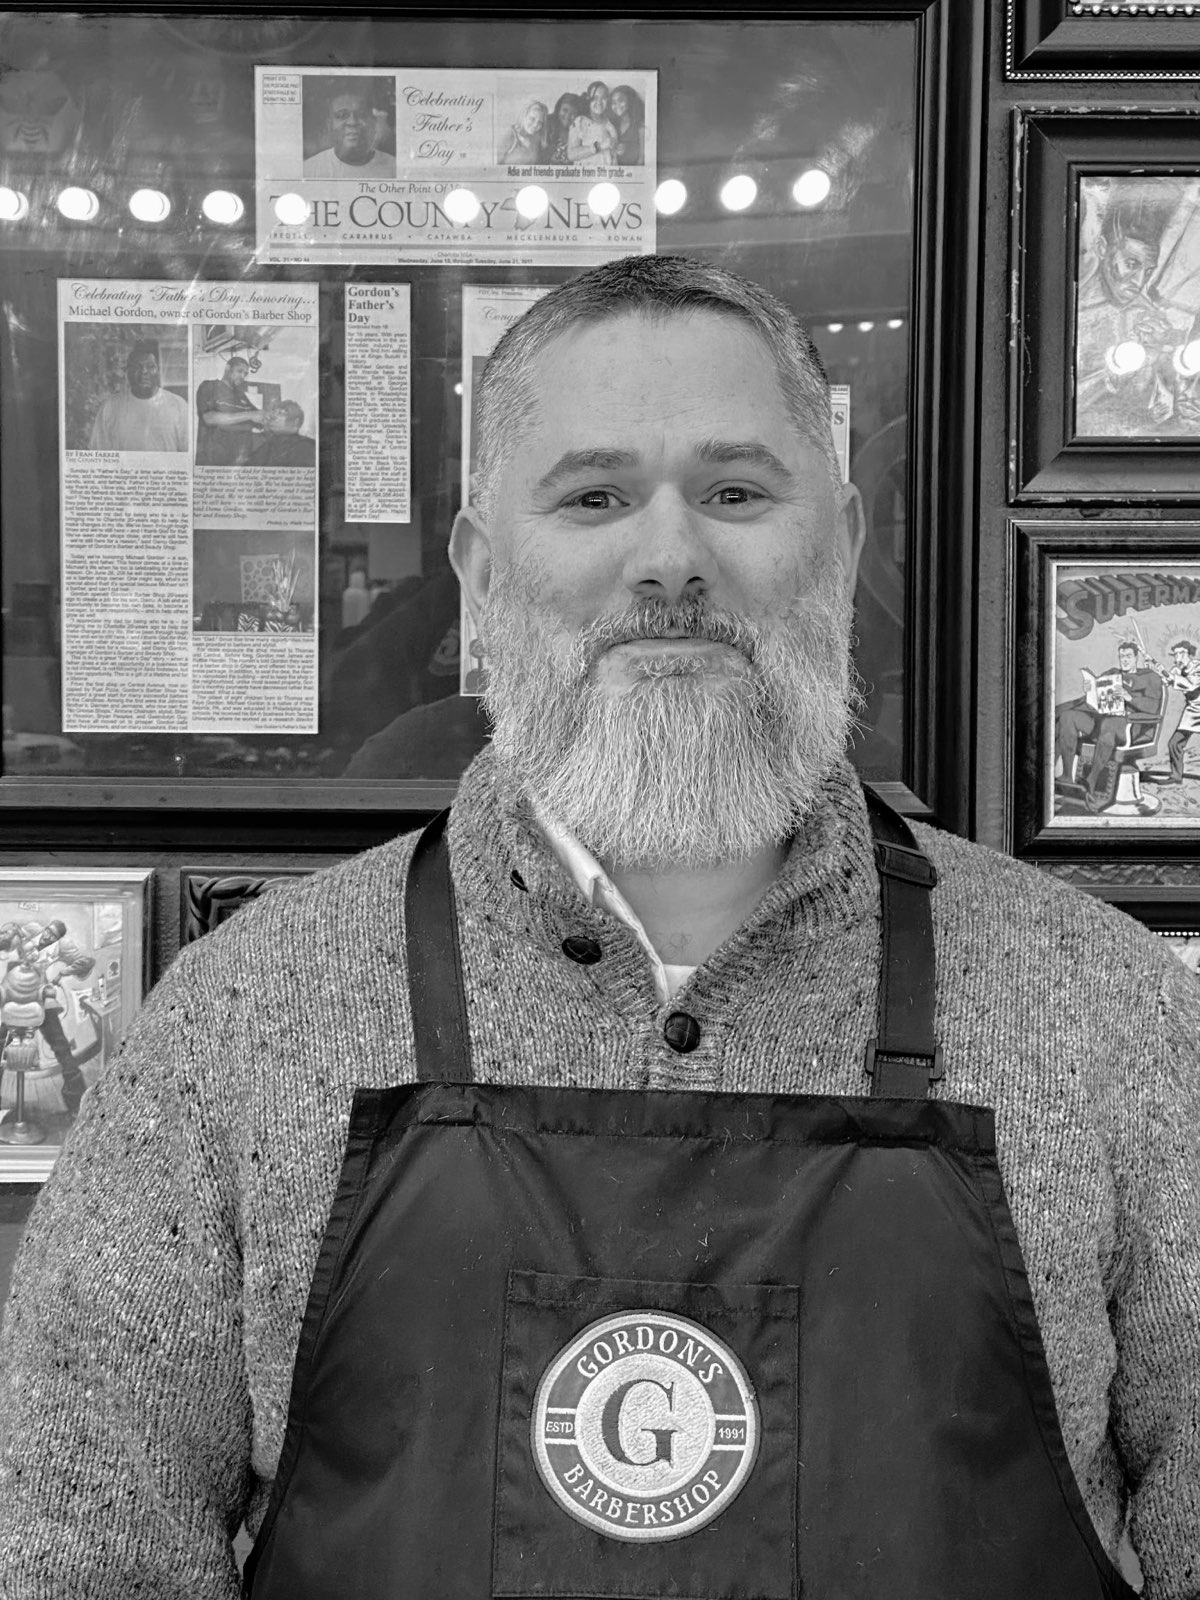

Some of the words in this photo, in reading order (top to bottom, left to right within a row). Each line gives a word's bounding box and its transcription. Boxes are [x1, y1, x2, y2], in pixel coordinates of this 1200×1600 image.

[403, 86, 485, 114] Celebrating
[412, 112, 473, 132] Father's
[417, 139, 455, 167] Day
[521, 166, 532, 177] and
[533, 166, 554, 177] friends
[555, 167, 580, 179] graduate
[582, 167, 595, 177] from
[608, 168, 625, 179] grade
[358, 183, 376, 194] The
[378, 183, 406, 194] Other
[408, 184, 432, 194] Point
[269, 194, 342, 227] HE
[349, 195, 500, 229] COUNY
[71, 282, 143, 307] Celebrating
[347, 286, 400, 298] Gordon's
[69, 305, 111, 317] Michael
[114, 306, 157, 319] Gordon,
[192, 308, 205, 319] of
[205, 309, 250, 320] Gordon's
[252, 310, 285, 321] Barber
[287, 311, 312, 323] Shop
[347, 299, 395, 310] Father's
[348, 312, 370, 325] Day
[576, 1325, 724, 1384] GORDON'S
[545, 1421, 574, 1434] ESTD
[601, 1378, 679, 1469] G
[718, 1427, 745, 1439] 1991
[563, 1463, 723, 1526] BARBERSHOP
